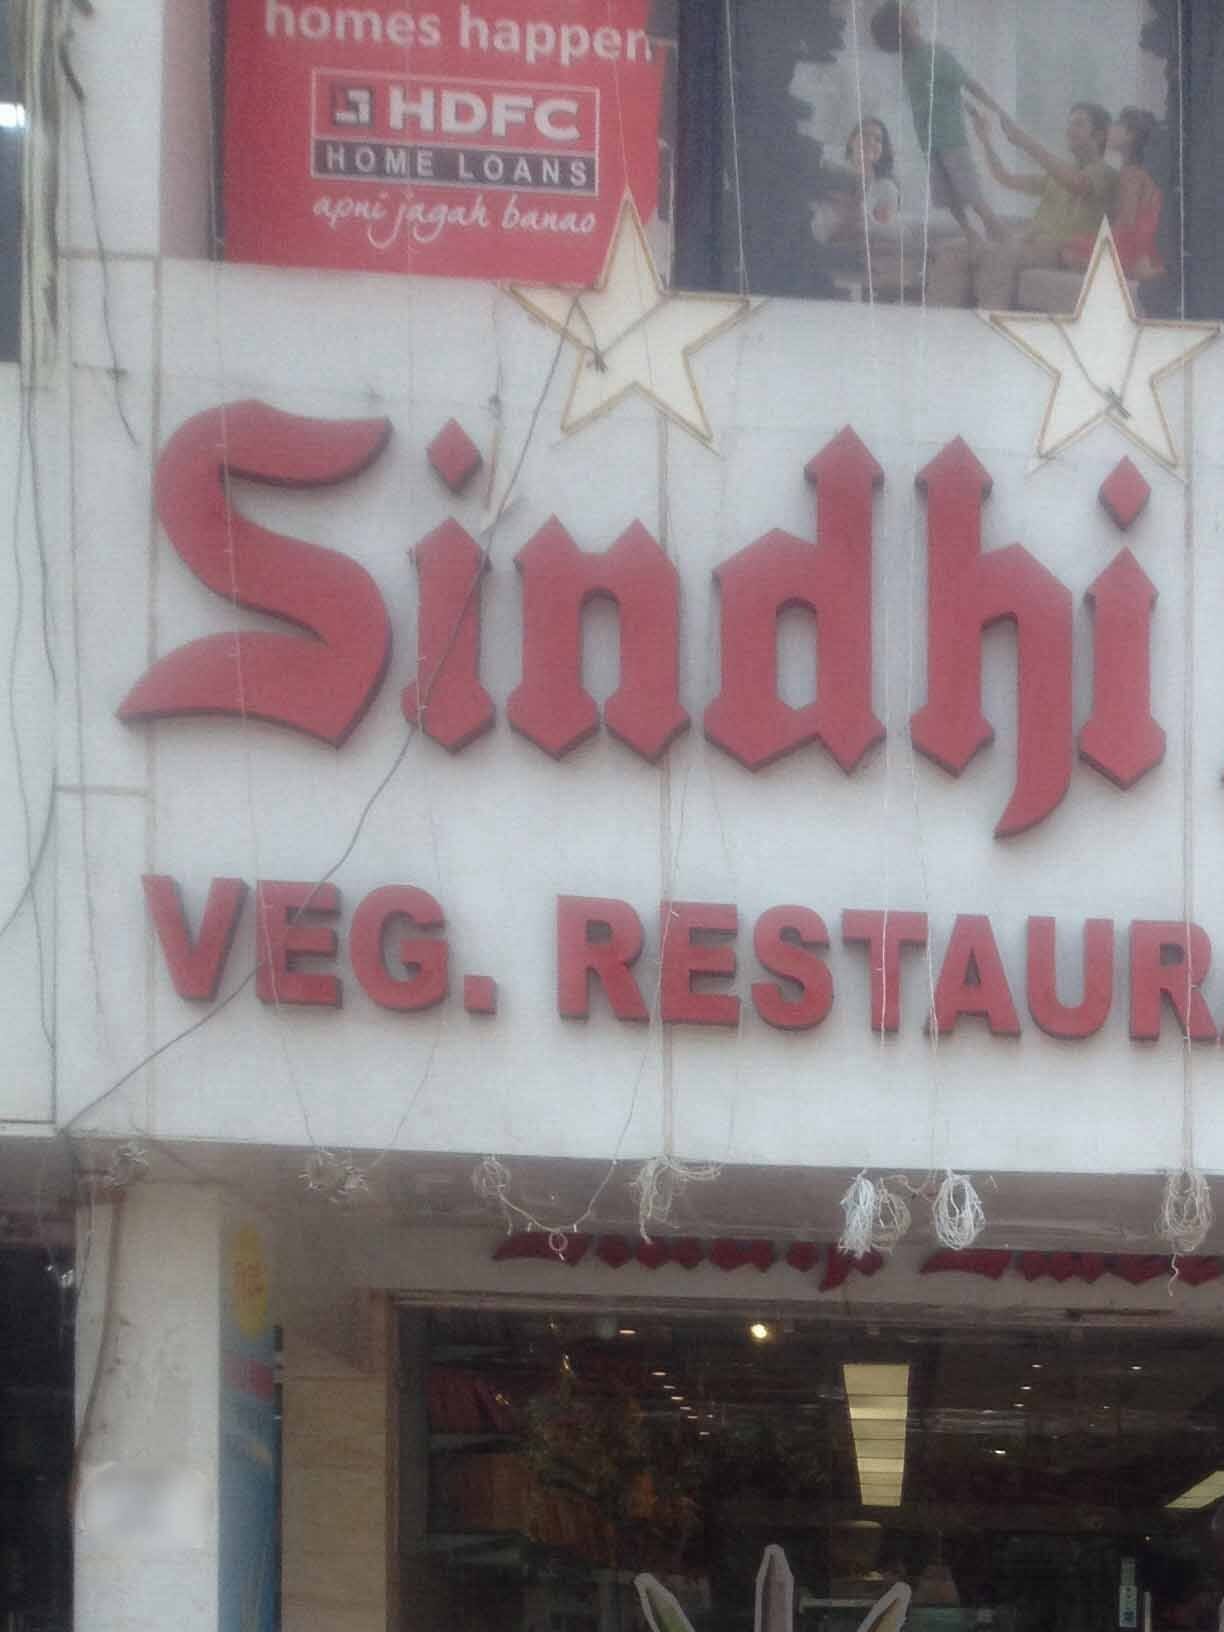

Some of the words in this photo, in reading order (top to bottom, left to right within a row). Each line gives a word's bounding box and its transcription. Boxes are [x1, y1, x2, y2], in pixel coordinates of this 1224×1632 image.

[264, 0, 441, 47] homes
[389, 85, 582, 141] HDFC
[326, 145, 434, 178] HOME
[458, 154, 588, 187] LOANS
[313, 192, 387, 229] apni
[368, 191, 490, 249] jagah
[503, 195, 598, 236] banao
[117, 399, 1167, 841] Sindhi
[141, 873, 497, 1018] VEG.
